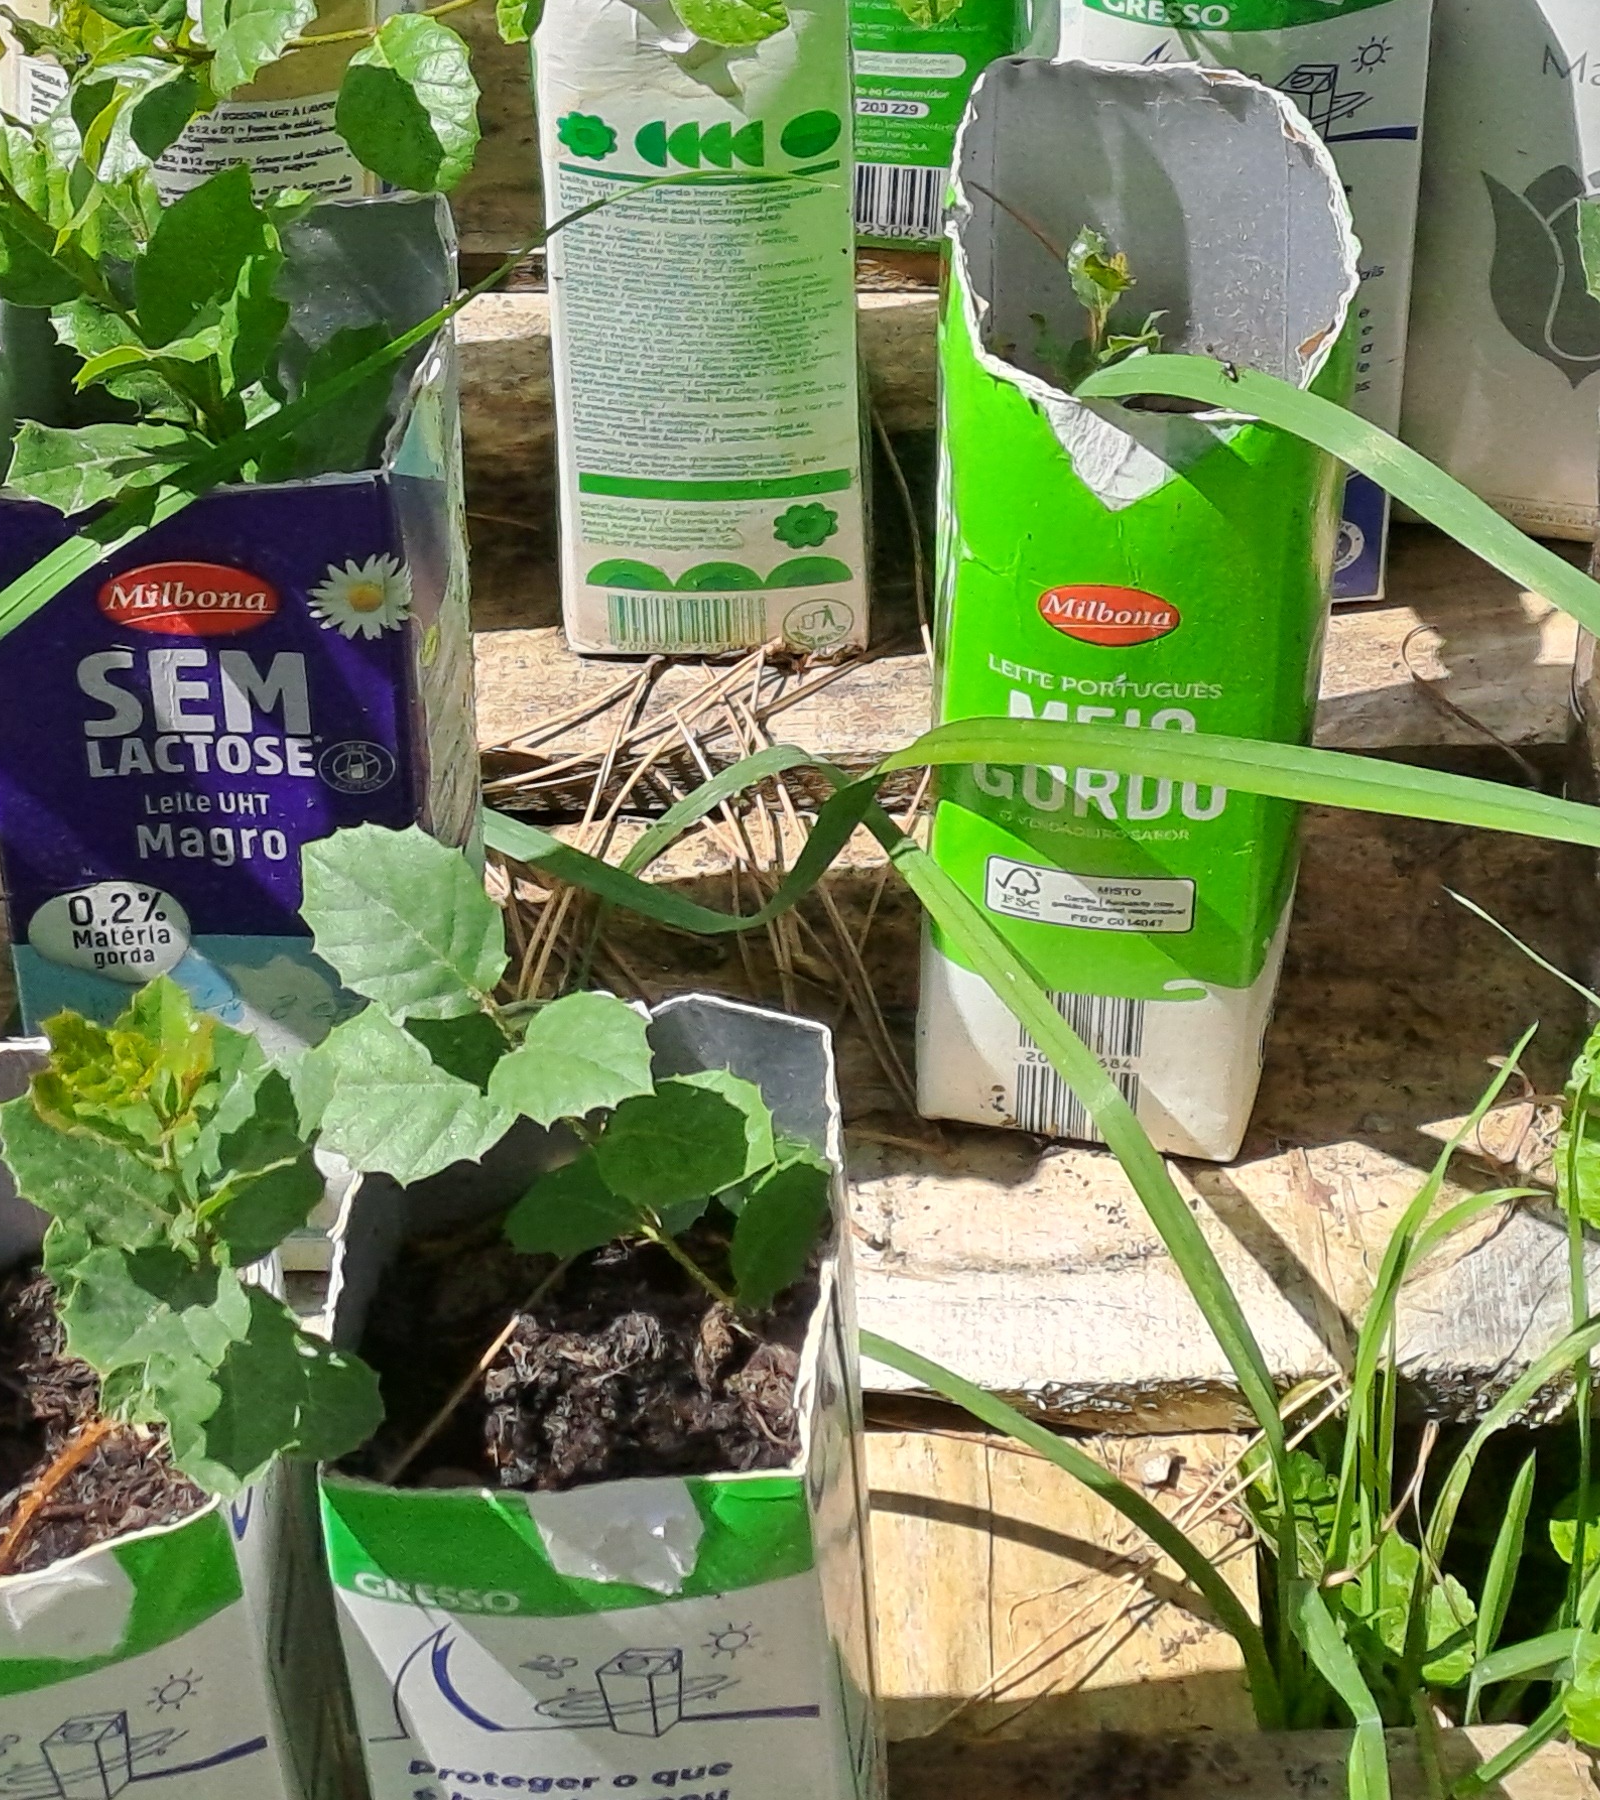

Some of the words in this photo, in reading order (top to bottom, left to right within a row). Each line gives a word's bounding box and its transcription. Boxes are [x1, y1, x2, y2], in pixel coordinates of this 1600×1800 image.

[892, 102, 919, 115] 229
[105, 583, 269, 614] Milbona
[1040, 590, 1173, 632] Milbona
[989, 653, 1054, 689] LEITE
[1062, 679, 1223, 699] PORTUGUÊS
[76, 648, 312, 737] SEM
[86, 734, 317, 778] LACTOSE
[144, 791, 211, 816] Leite
[218, 794, 270, 816] UHT
[136, 825, 289, 866] Magro
[1002, 893, 1040, 909] FSC
[1098, 886, 1142, 896] MISTO
[72, 925, 171, 949] Matéria
[94, 948, 155, 969] gorda
[353, 1571, 521, 1614] GRESSO
[408, 1759, 600, 1791] Proteger
[611, 1772, 638, 1789] o
[651, 1759, 732, 1788] que
